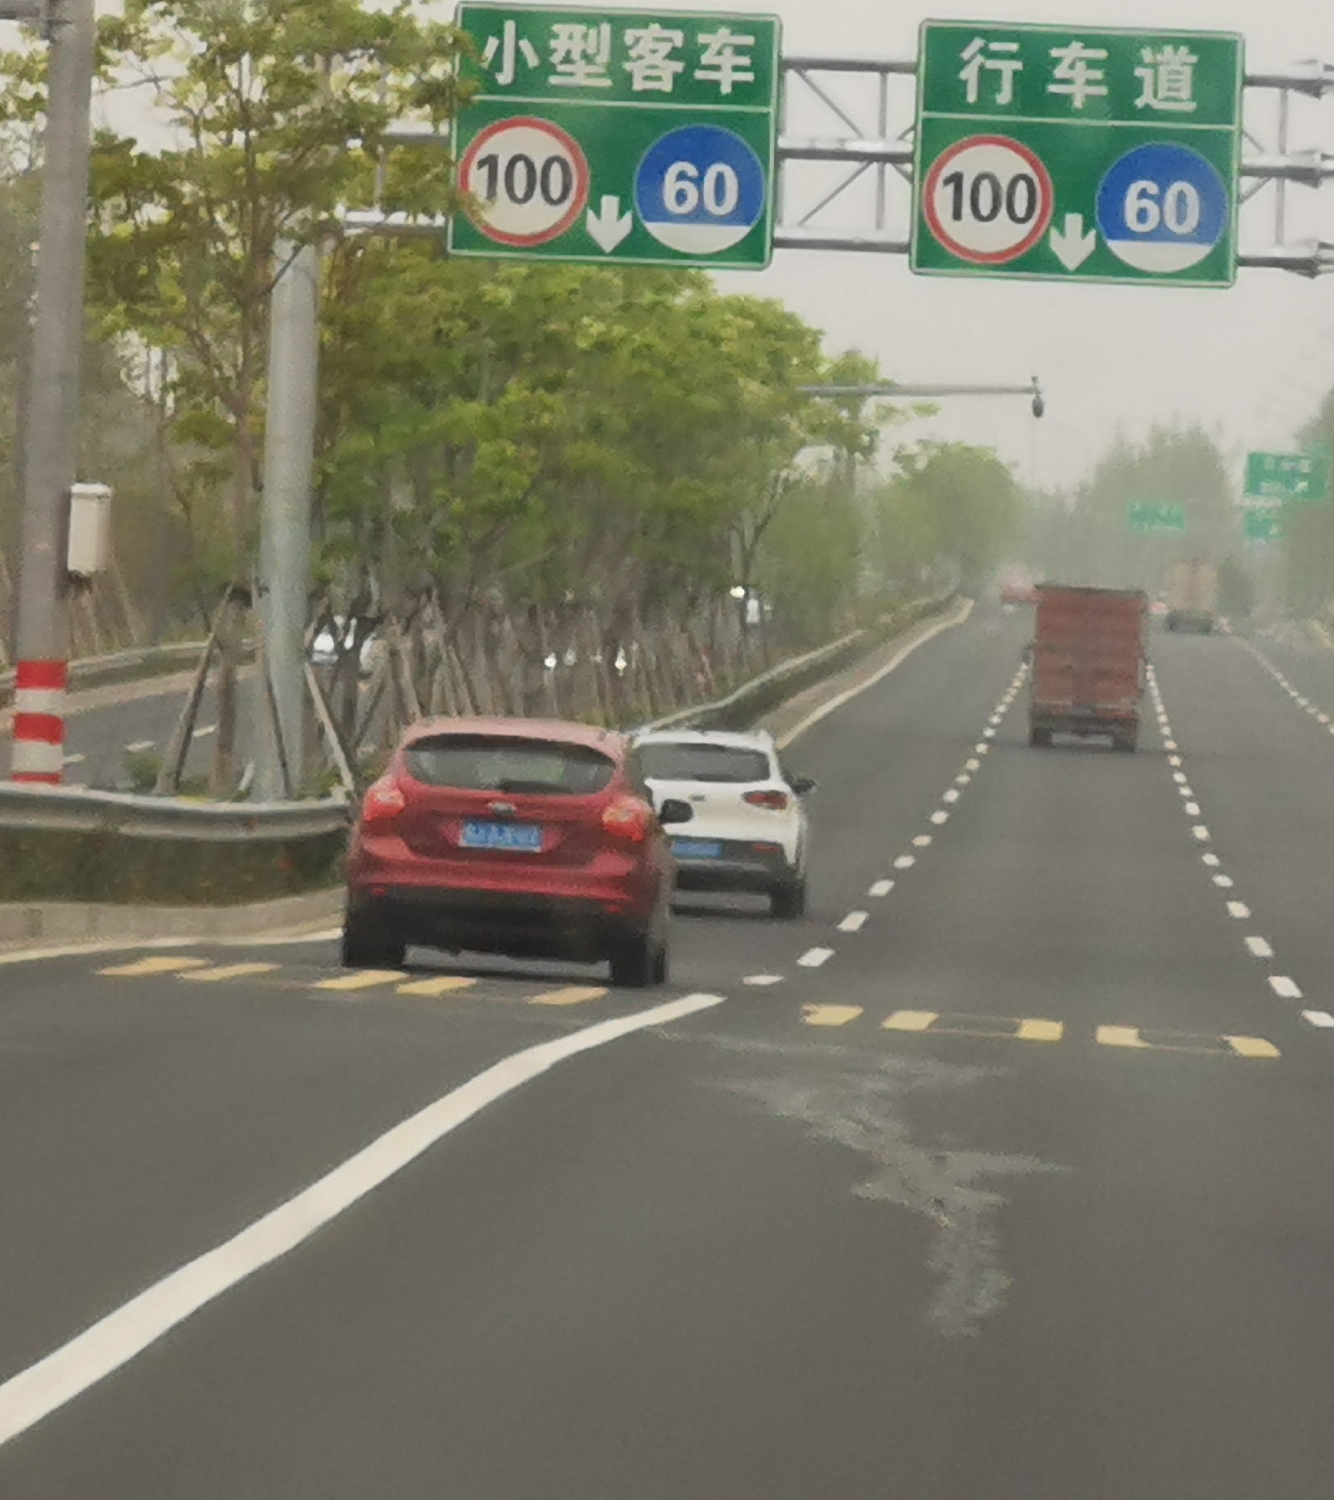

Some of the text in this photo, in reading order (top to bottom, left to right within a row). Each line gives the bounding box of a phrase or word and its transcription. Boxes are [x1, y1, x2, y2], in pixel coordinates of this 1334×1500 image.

[482, 19, 755, 95] 小型客车
[959, 37, 1198, 112] 行车道
[476, 153, 573, 206] 100
[662, 161, 739, 216] 60
[942, 171, 1038, 224] 100
[1124, 180, 1200, 234] 60
